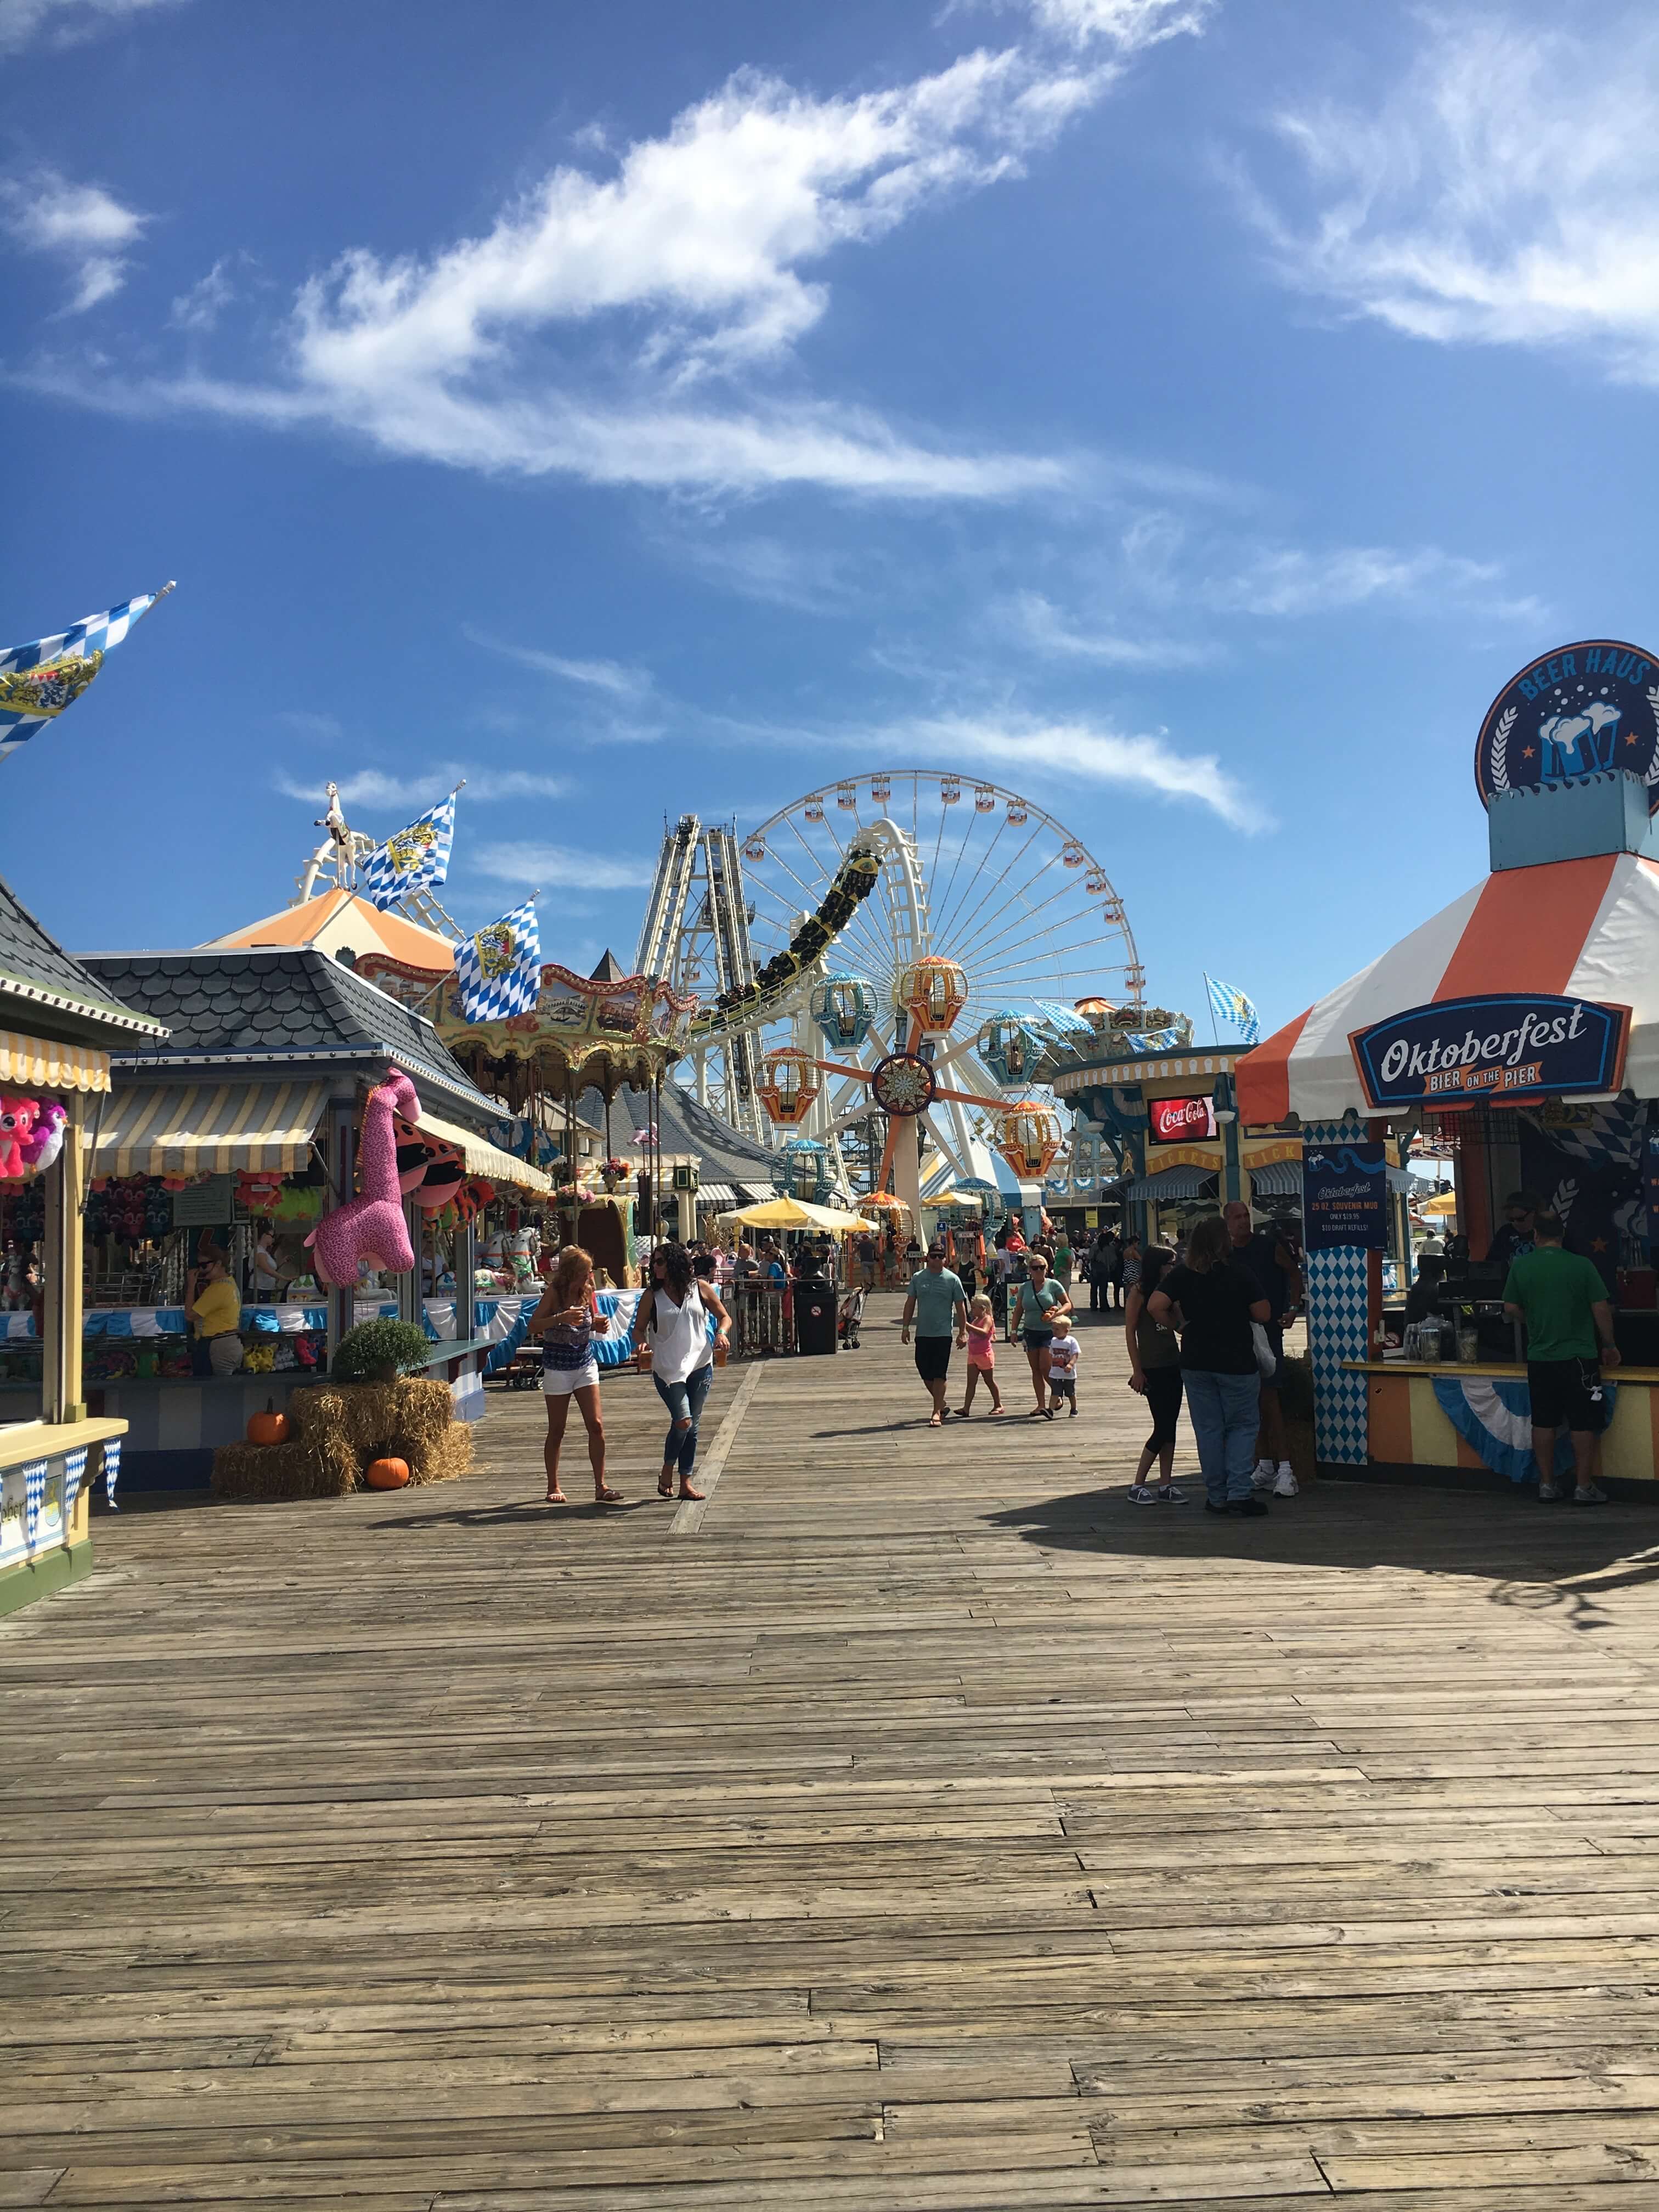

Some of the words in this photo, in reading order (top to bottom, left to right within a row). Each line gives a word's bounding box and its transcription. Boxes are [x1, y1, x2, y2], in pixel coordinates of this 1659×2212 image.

[1519, 653, 1577, 701] BEER
[1585, 648, 1651, 685] HAUS
[1380, 1002, 1588, 1083] Oktoberfest
[1430, 1070, 1461, 1092] BIER
[1467, 1075, 1480, 1088] ON
[1483, 1069, 1500, 1084] THE
[1504, 1066, 1536, 1087] PIER
[1160, 1099, 1206, 1133] Coca-Cola
[1148, 1150, 1219, 1172] TICKETS
[1246, 1145, 1295, 1166] TICK
[1317, 1181, 1372, 1200] Oktoberfest
[1312, 1202, 1320, 1211] 25
[1331, 1202, 1362, 1210] SOUVENIR
[1363, 1201, 1379, 1210] MUG
